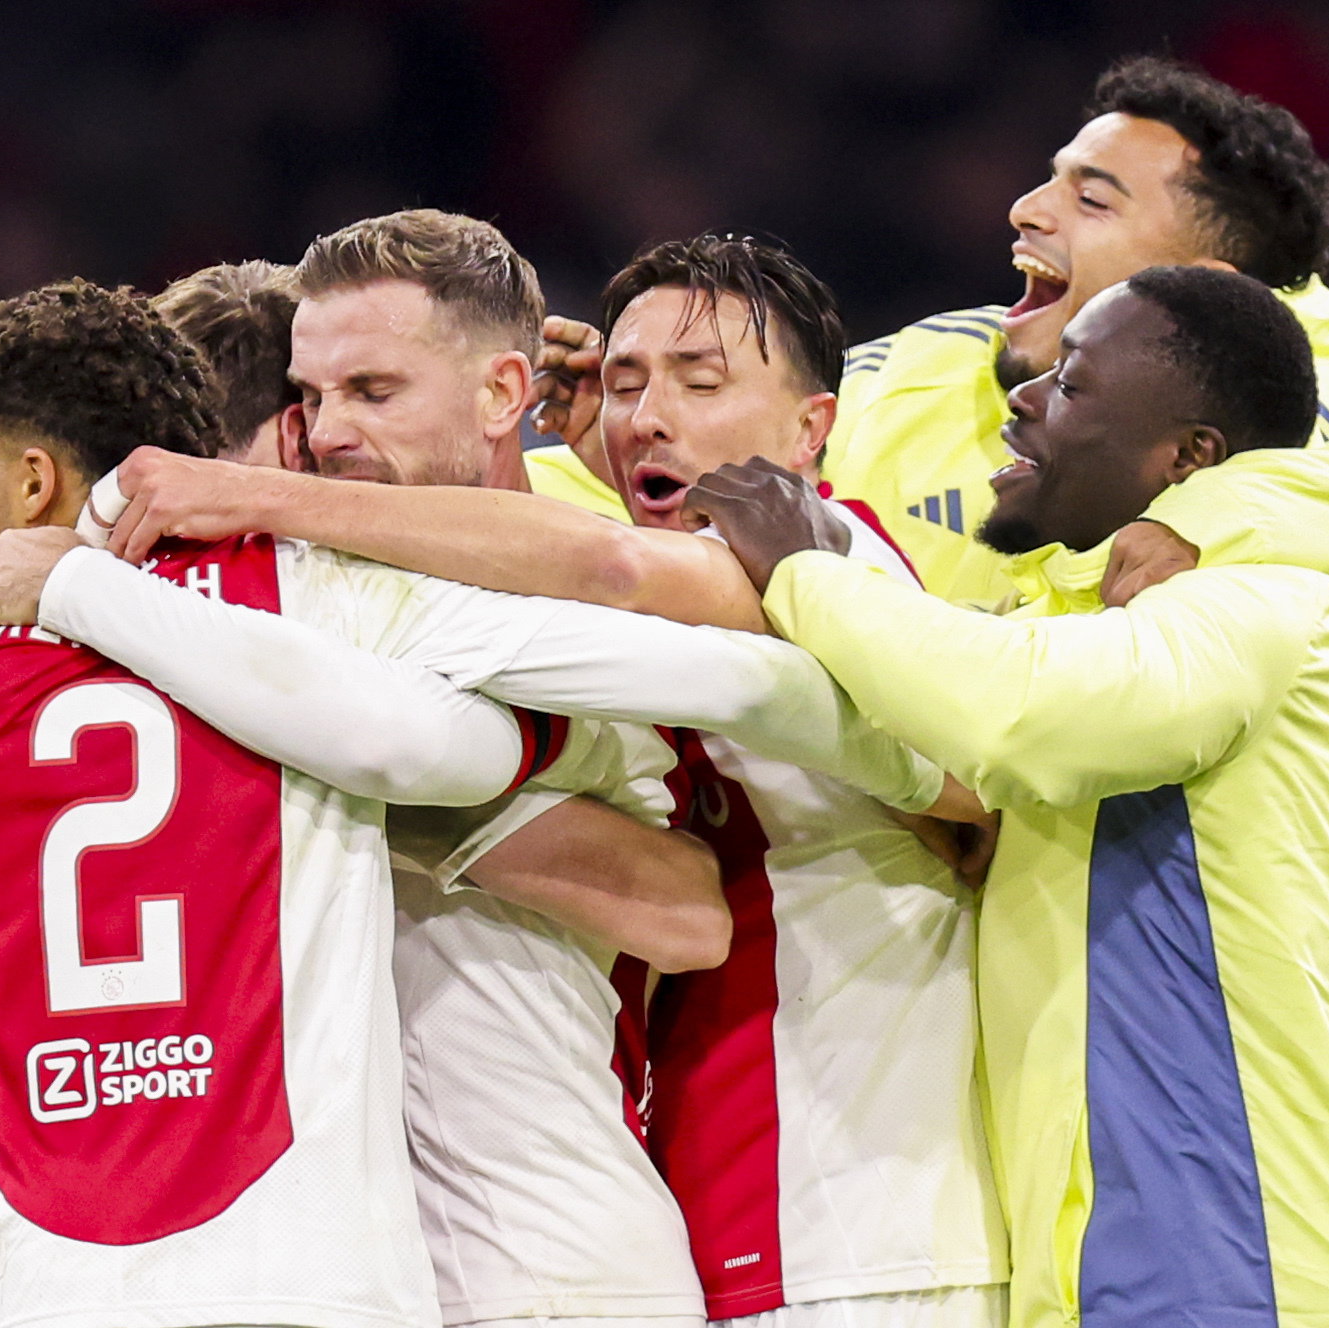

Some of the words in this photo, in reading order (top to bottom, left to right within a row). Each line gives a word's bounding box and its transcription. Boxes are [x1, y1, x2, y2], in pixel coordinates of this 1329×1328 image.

[30, 678, 186, 1016] 2
[98, 1033, 214, 1073] ZIGGO
[100, 1067, 213, 1106] SPORT
